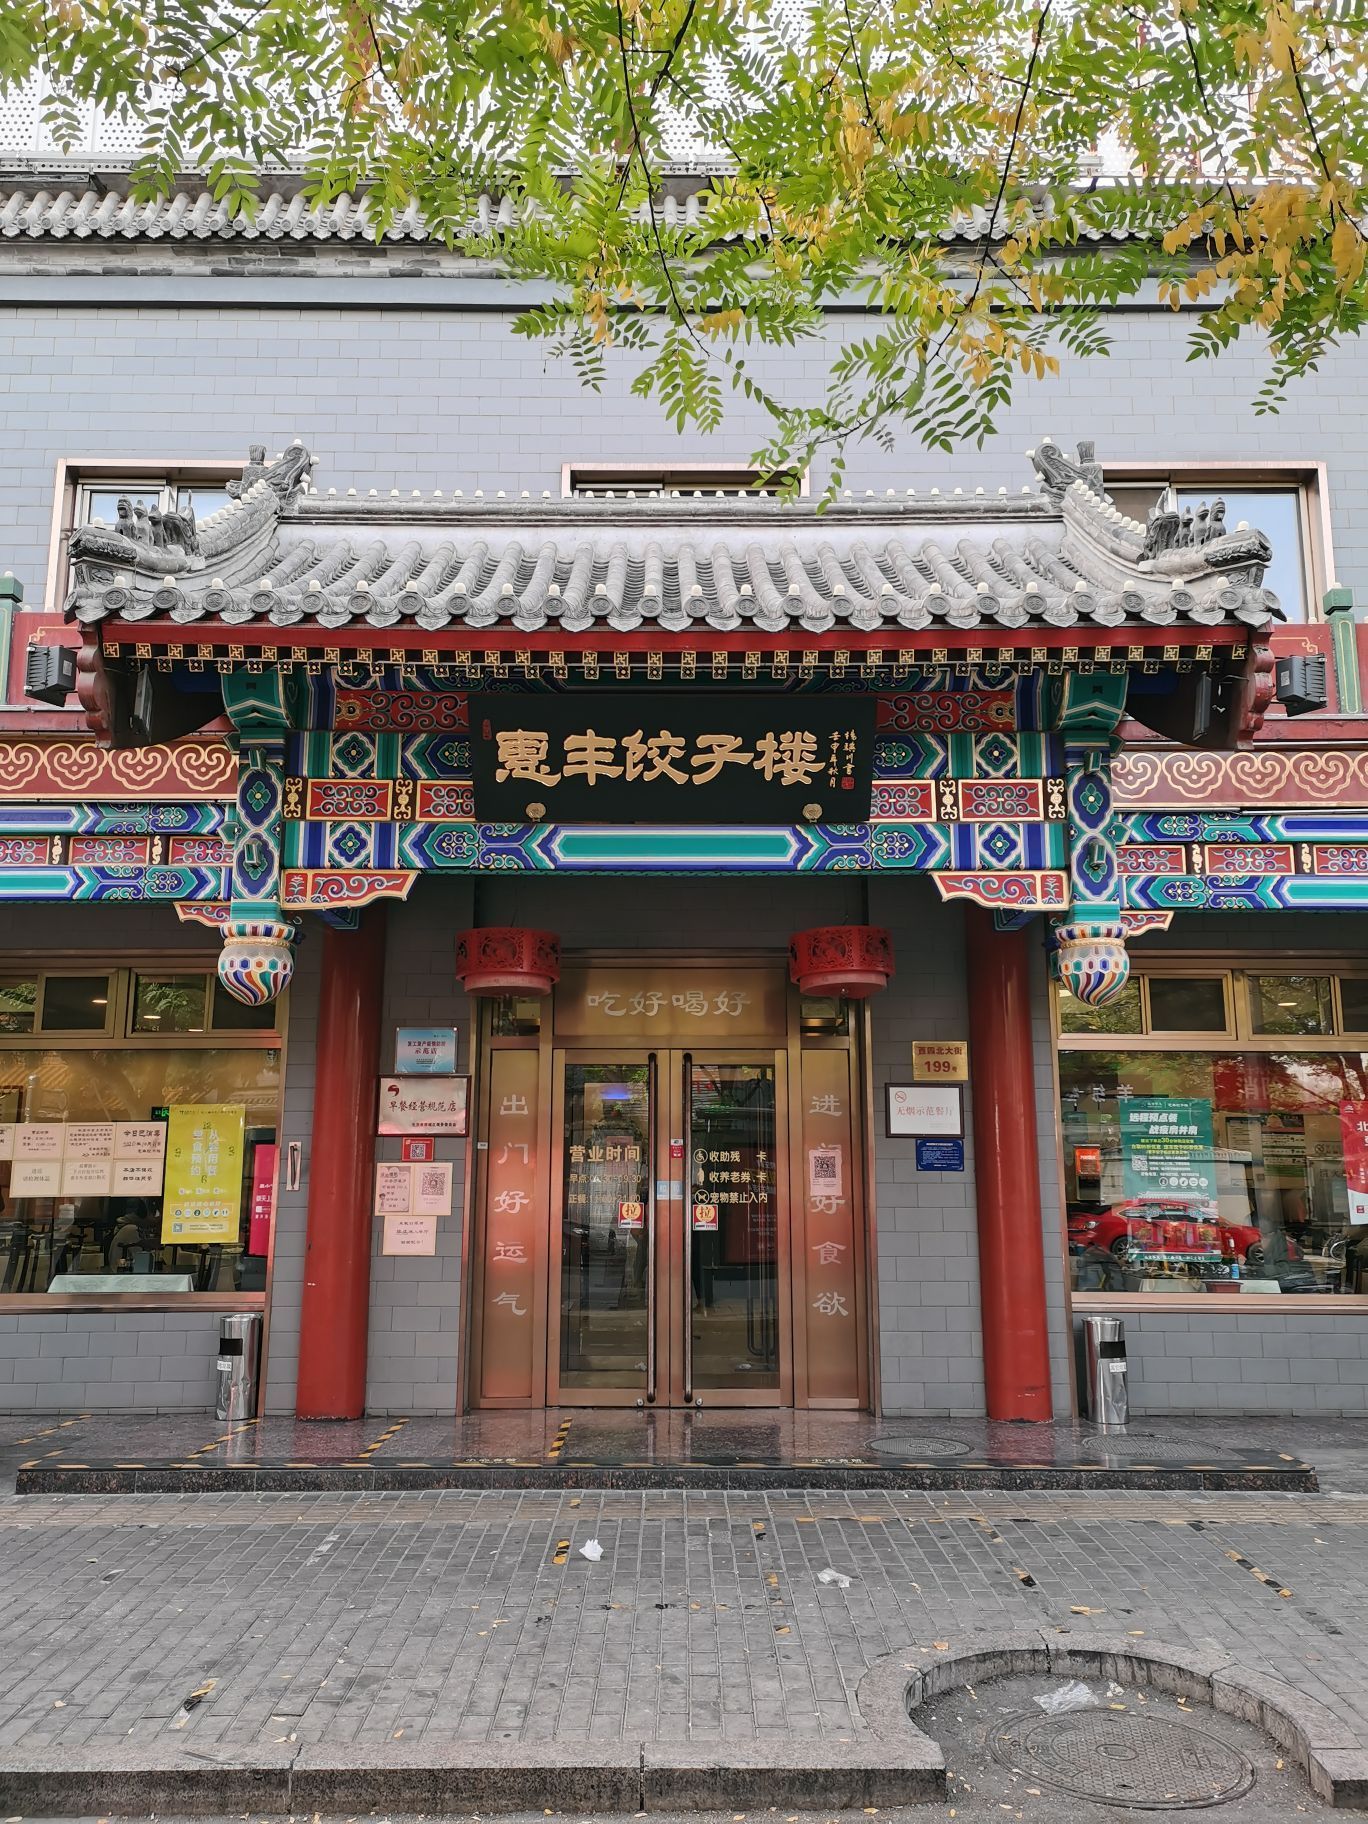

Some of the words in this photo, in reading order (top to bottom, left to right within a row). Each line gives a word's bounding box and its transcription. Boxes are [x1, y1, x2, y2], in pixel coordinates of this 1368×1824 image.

[495, 729, 826, 786] 惠丰饺子楼
[587, 990, 751, 1017] 吃好喝好
[918, 1046, 963, 1055] 西四北大街
[389, 1101, 457, 1112] 早餐经营规范店
[569, 1145, 640, 1163] 营业时间
[709, 1151, 741, 1163] 收助残
[756, 1151, 767, 1163] 卡
[709, 1192, 768, 1203] 宠物禁止入内
[492, 1094, 529, 1317] 出门好运气
